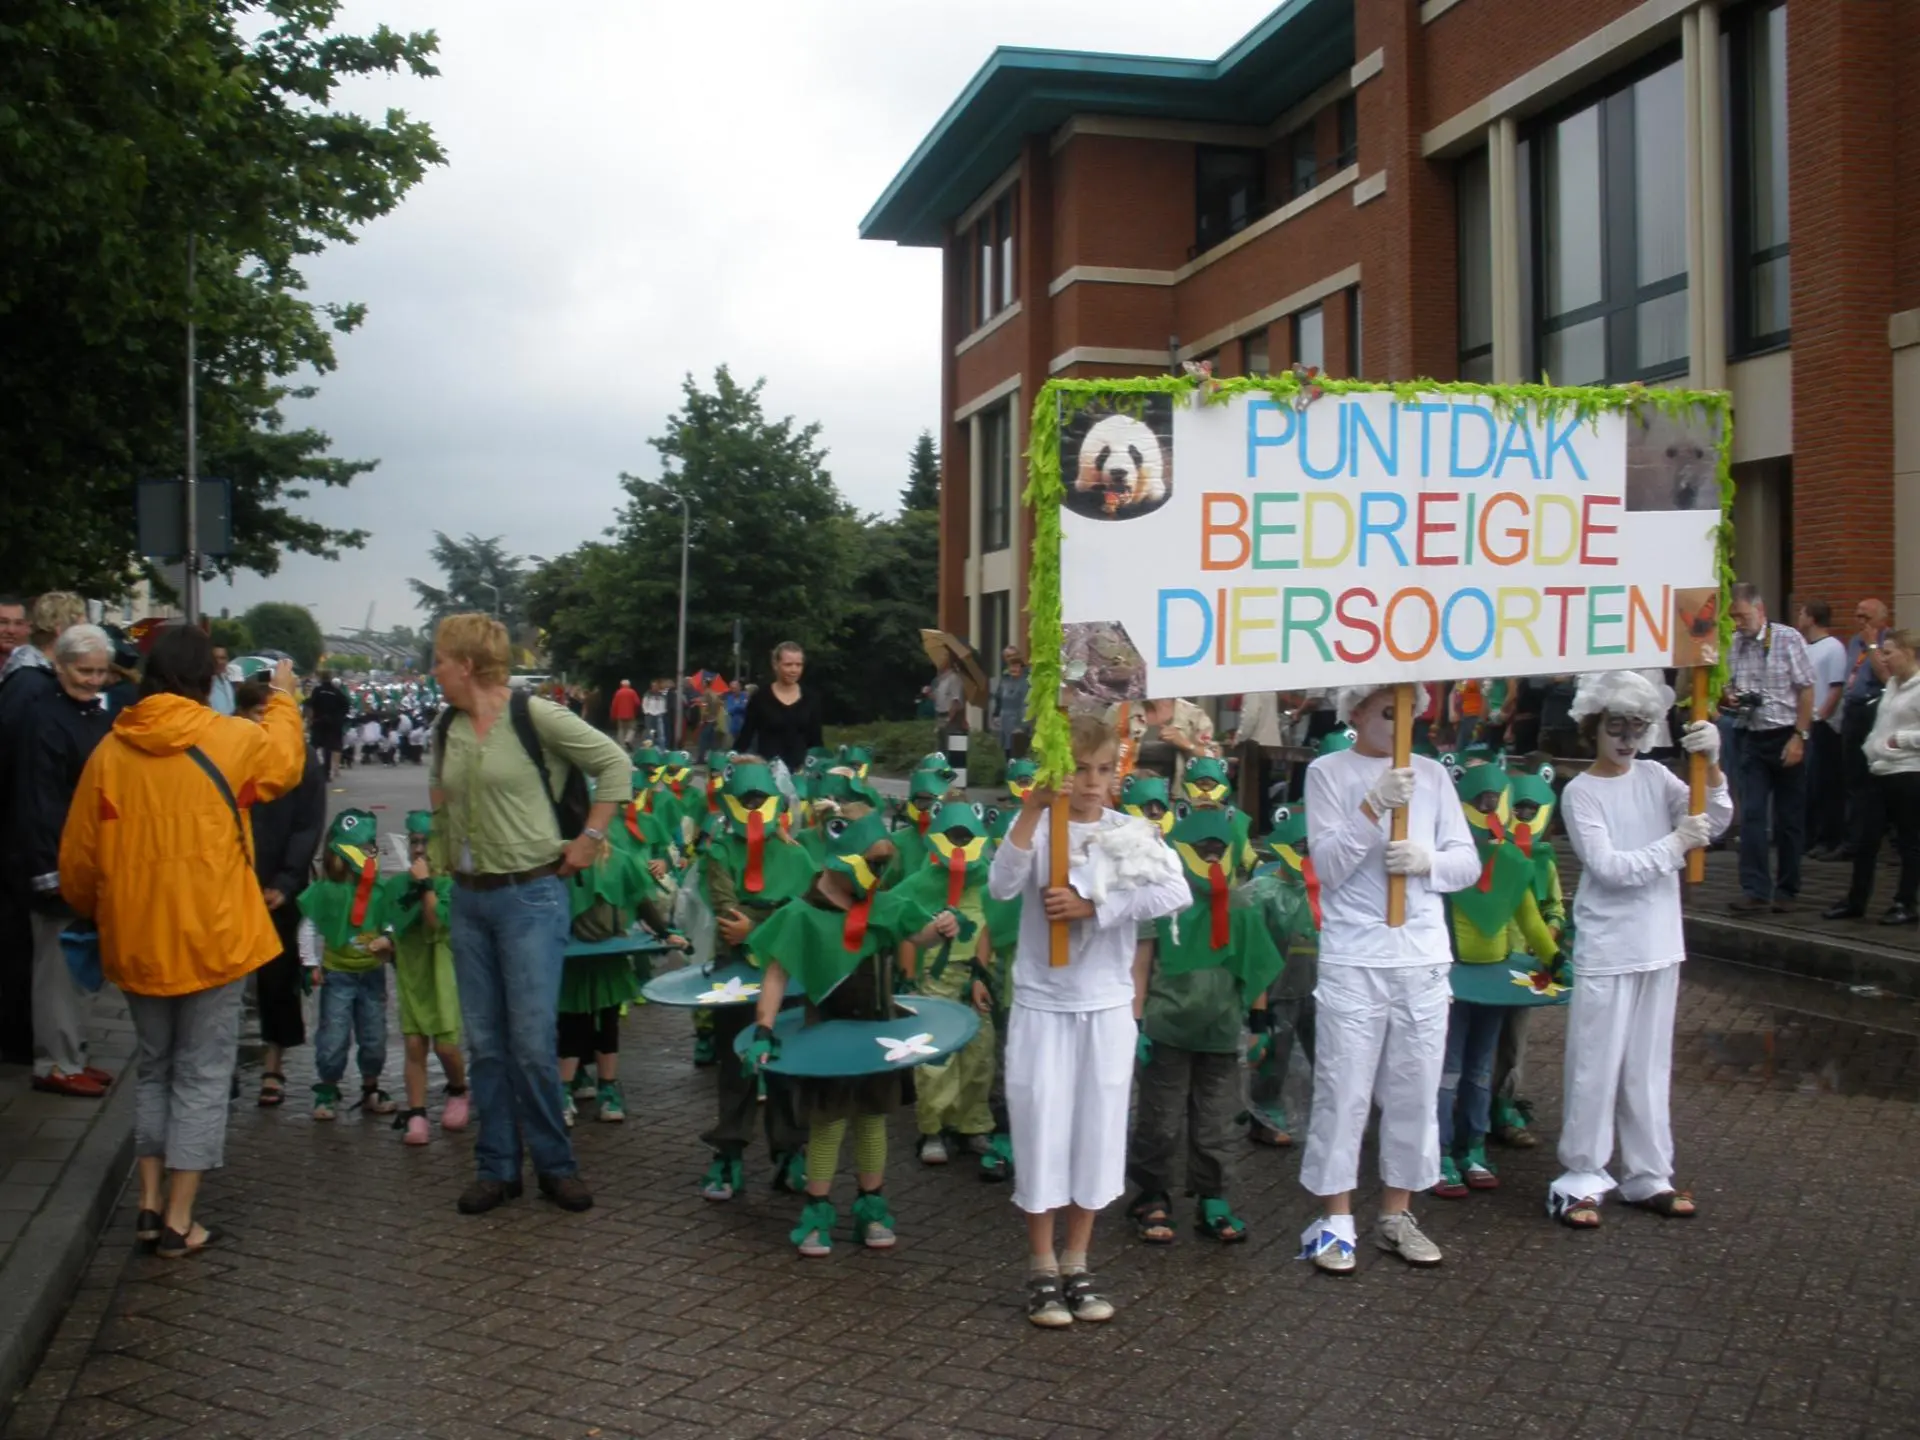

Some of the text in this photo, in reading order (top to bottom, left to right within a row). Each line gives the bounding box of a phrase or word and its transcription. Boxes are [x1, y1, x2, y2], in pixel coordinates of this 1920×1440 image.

[1246, 397, 1590, 480] PUNTDAK
[1201, 492, 1622, 571] BEDREIGDE
[1157, 583, 1671, 668] DIERSOORTEN
